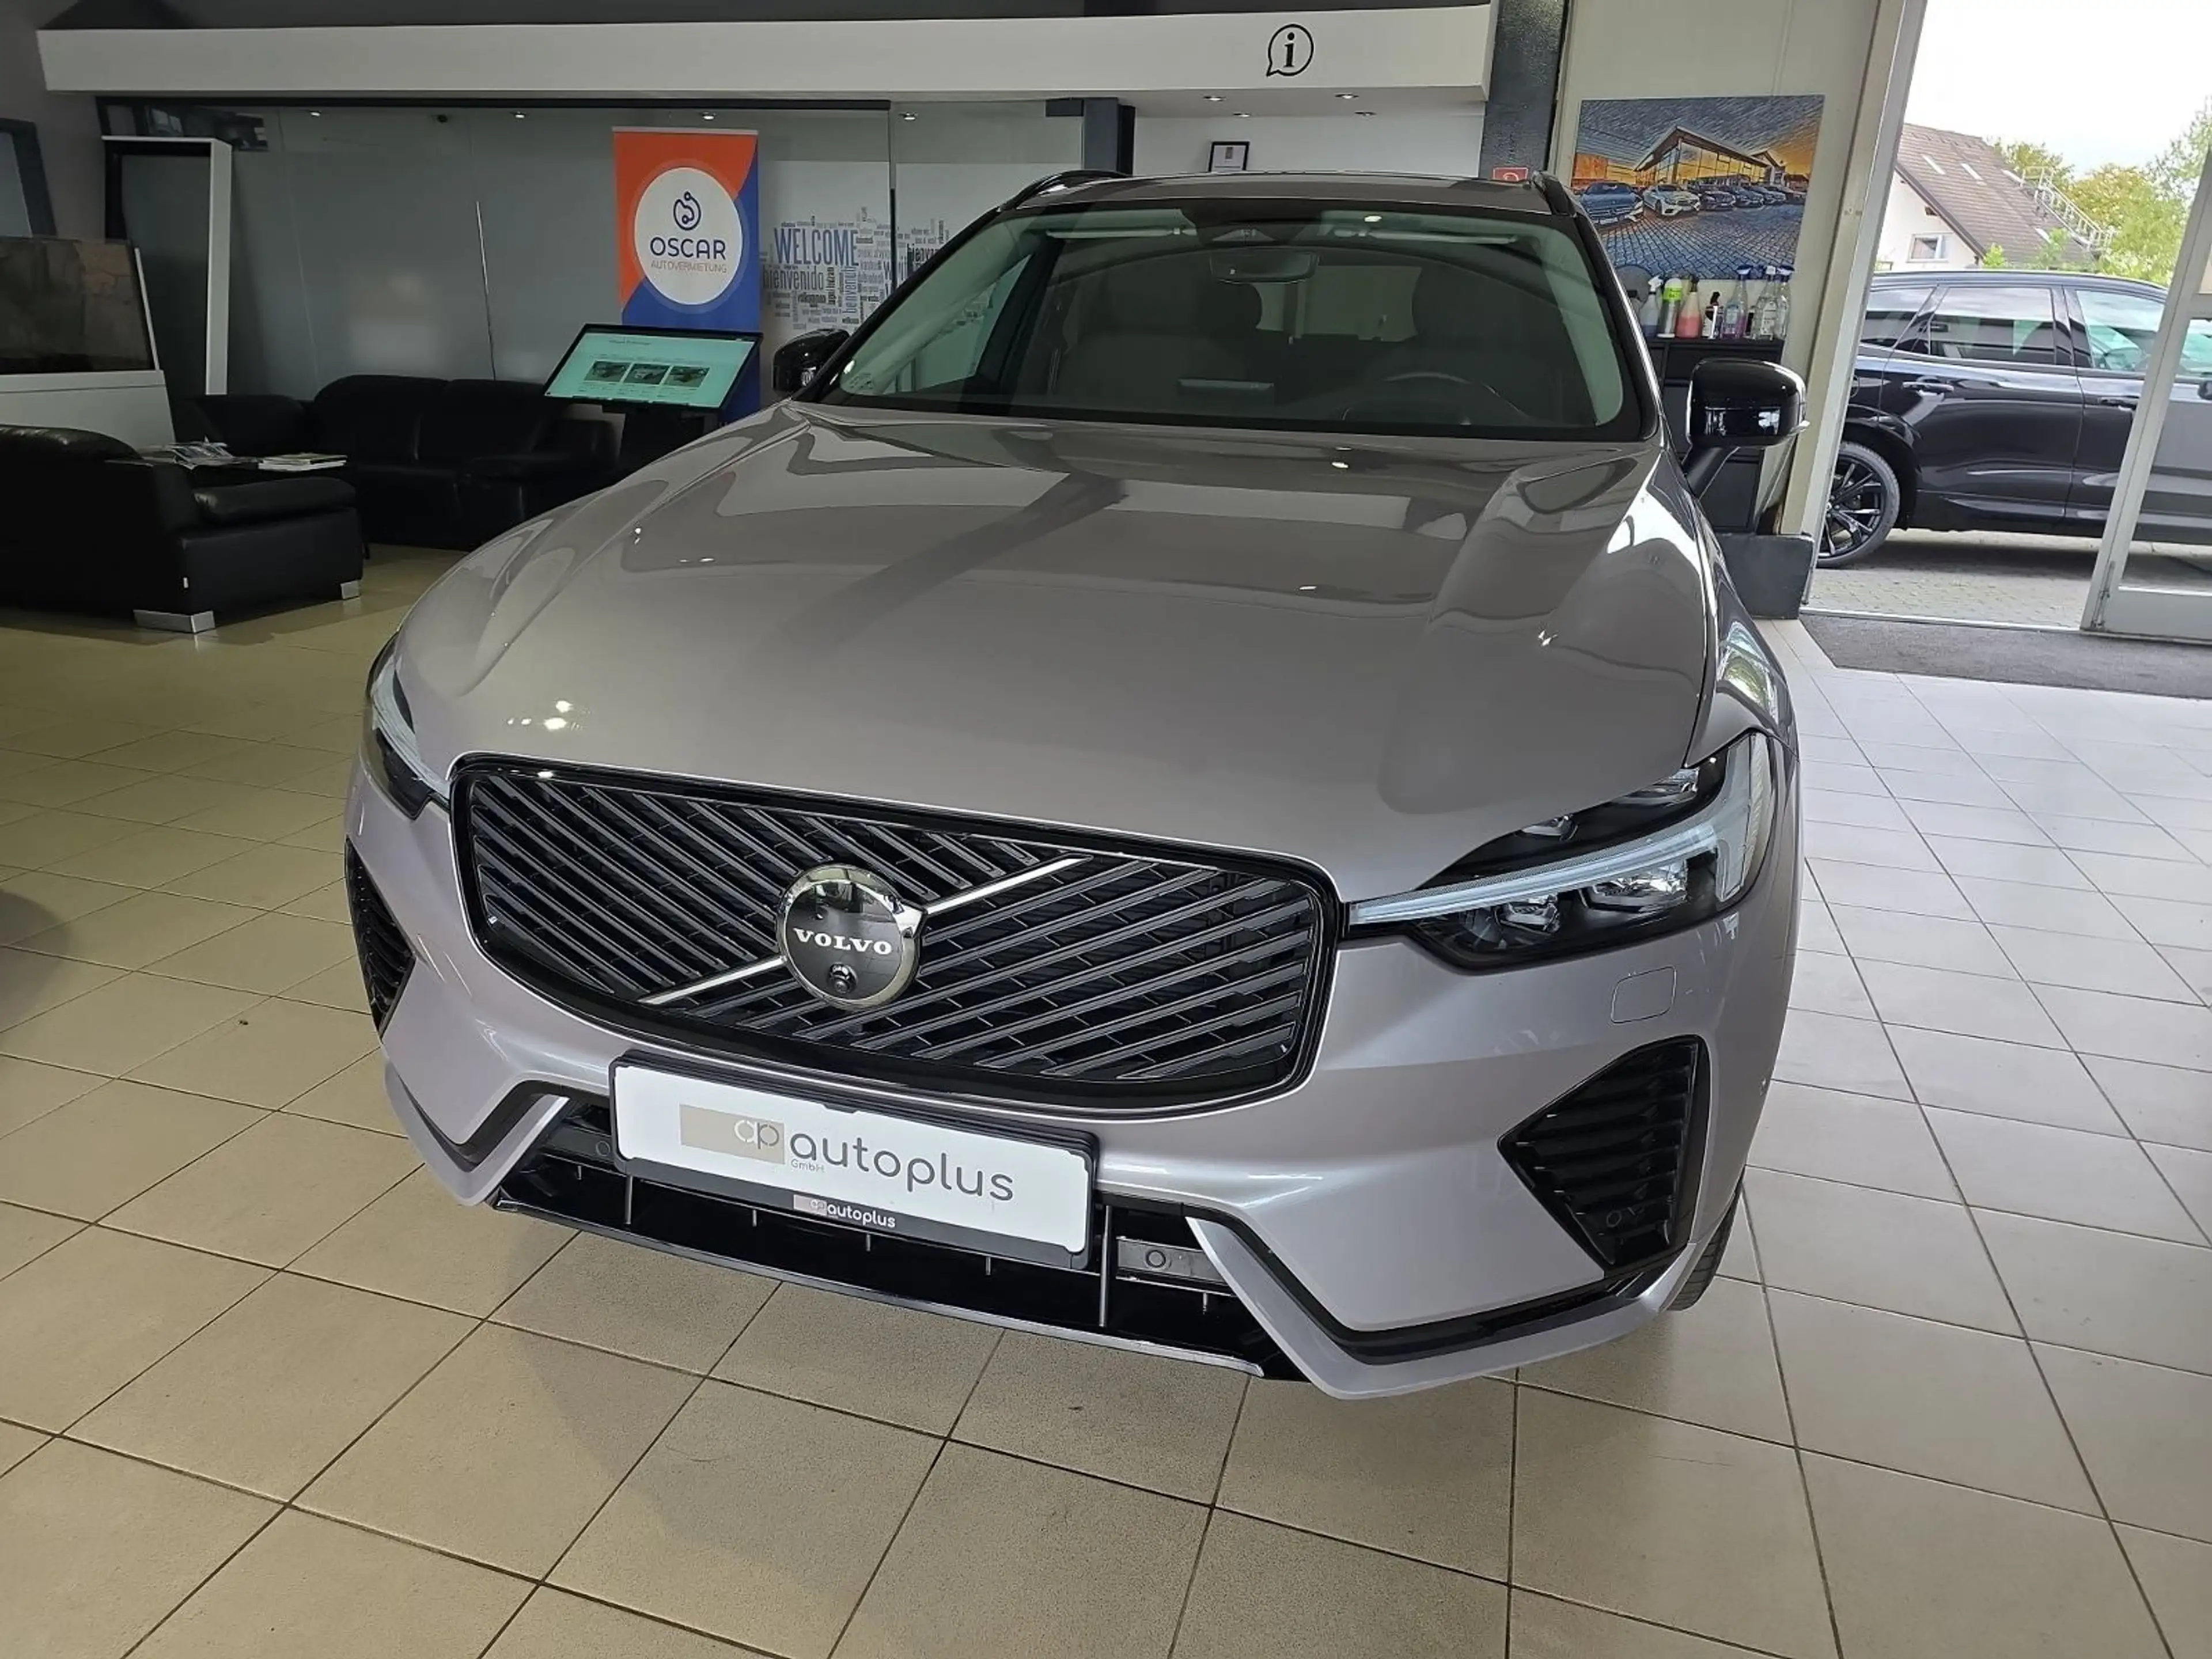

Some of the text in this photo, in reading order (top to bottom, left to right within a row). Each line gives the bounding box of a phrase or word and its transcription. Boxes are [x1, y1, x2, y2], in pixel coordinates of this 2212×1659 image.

[650, 237, 726, 260] OSCAR
[774, 228, 859, 266] WELCOME
[763, 264, 824, 290] bienvenido
[793, 927, 892, 955] VOLVO
[790, 1133, 1014, 1201] autoplus
[791, 1158, 825, 1173] GmbH
[827, 1204, 896, 1228] autoplus
